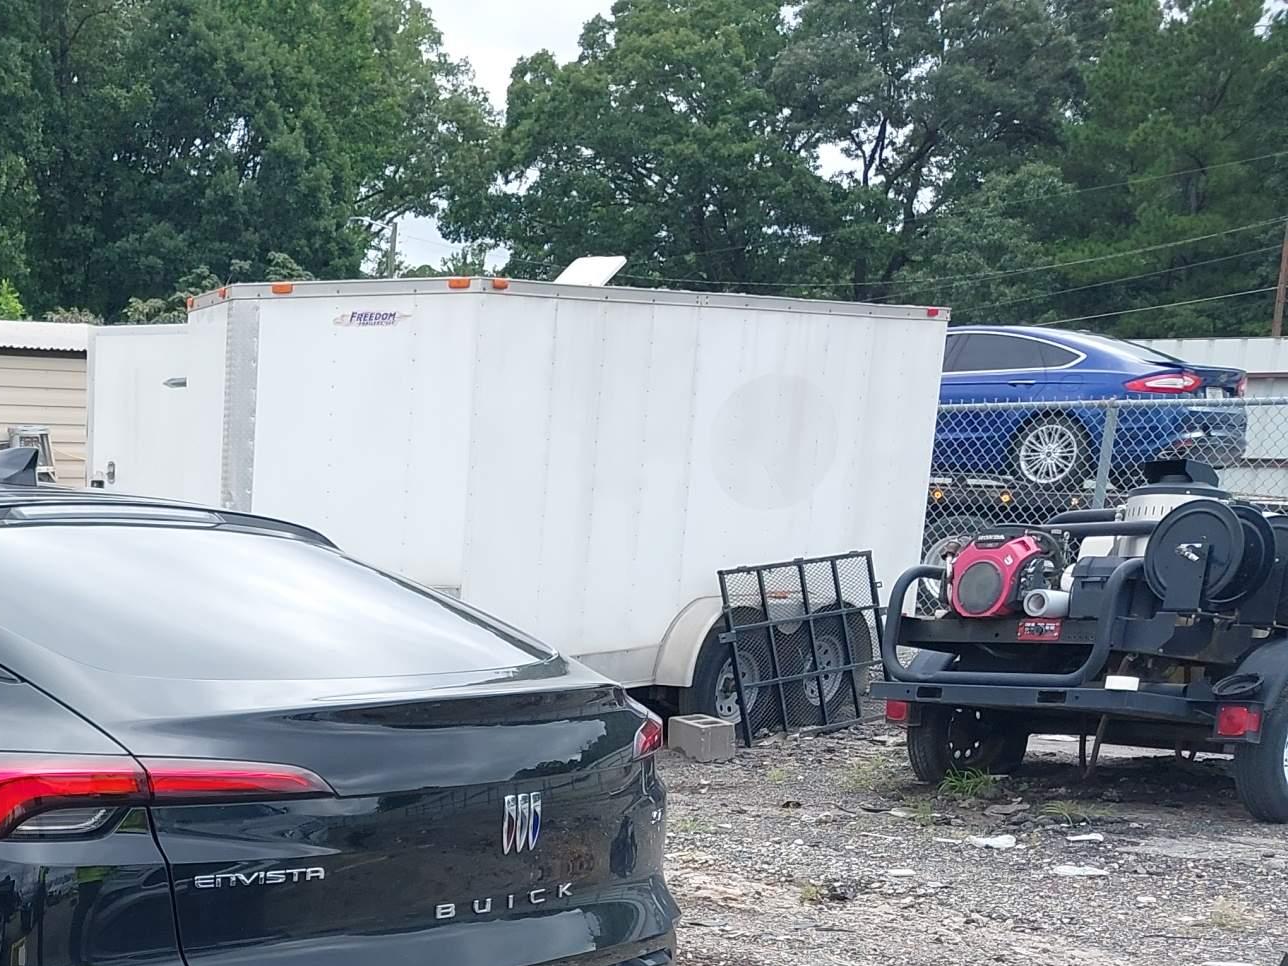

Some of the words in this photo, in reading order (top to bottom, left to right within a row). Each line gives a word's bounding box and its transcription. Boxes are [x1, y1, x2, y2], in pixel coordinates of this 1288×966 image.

[350, 311, 396, 322] FREEDOM
[194, 867, 325, 889] ENVISTA
[435, 882, 573, 920] BUICK
